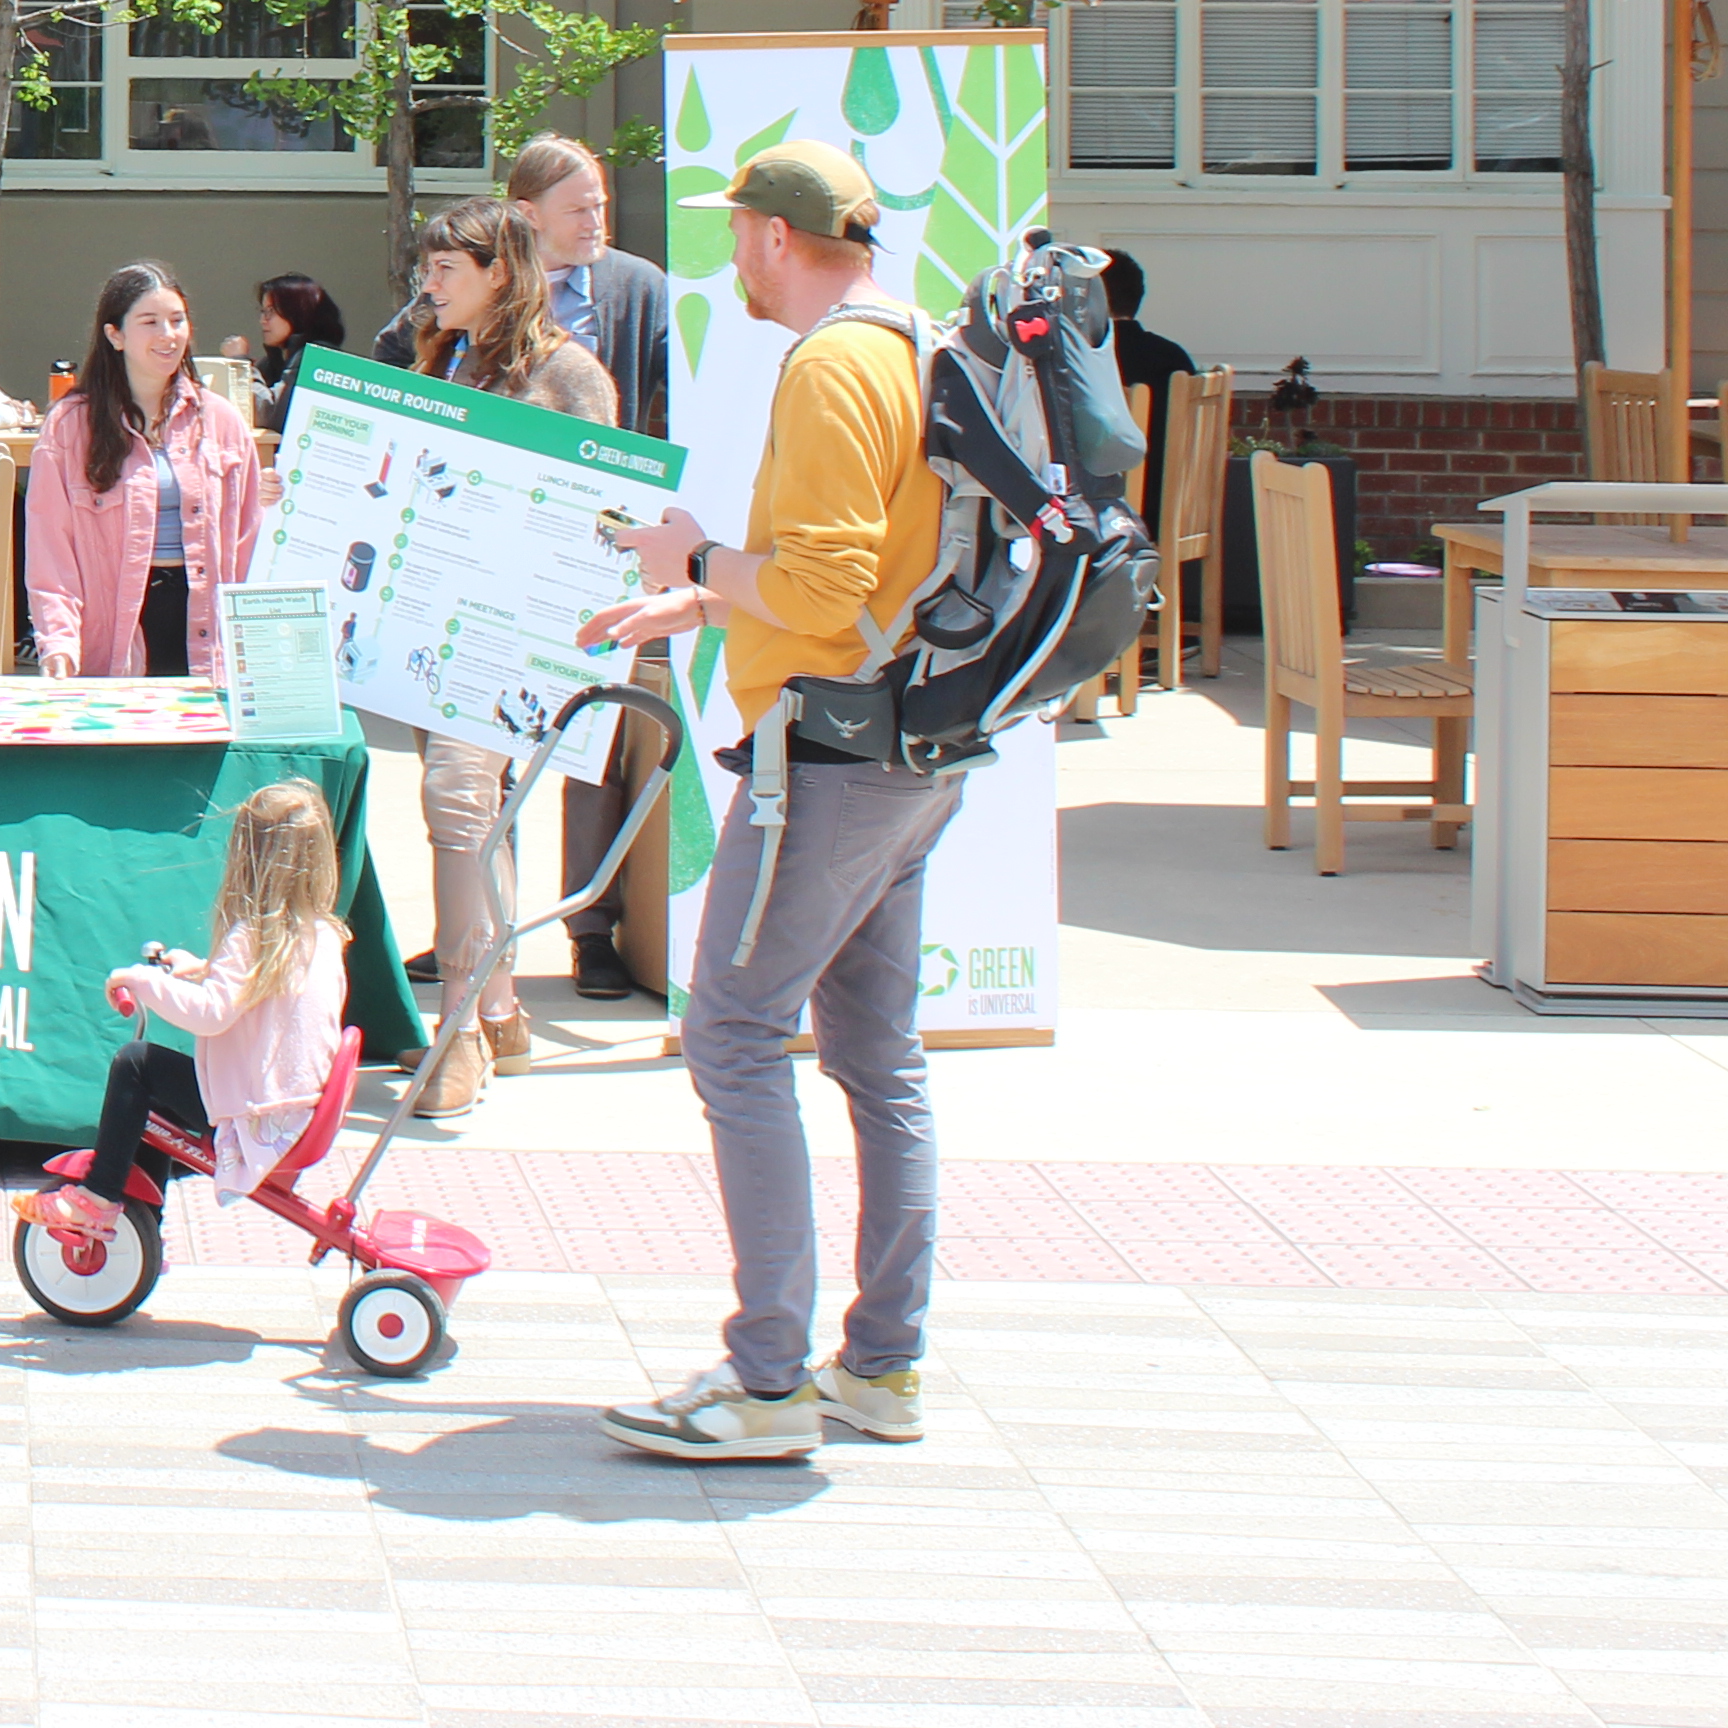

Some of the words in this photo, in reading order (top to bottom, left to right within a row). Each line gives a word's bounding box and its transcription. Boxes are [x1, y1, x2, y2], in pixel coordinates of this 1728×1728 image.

[313, 368, 361, 393] GREEN
[363, 381, 402, 404] YOUR
[402, 392, 469, 422] ROUTINE
[312, 419, 355, 438] MORNING
[314, 409, 344, 424] START
[344, 418, 370, 432] YOUR
[536, 472, 570, 489] LUNCH
[570, 482, 604, 498] BREAK
[242, 597, 261, 605] Earth
[285, 595, 307, 603] Watch
[456, 596, 468, 607] IN
[468, 598, 516, 621] MEETINGS
[530, 656, 552, 671] END
[553, 663, 579, 679] YOUR
[580, 672, 602, 684] DAY
[968, 946, 1035, 990] GREEN
[968, 994, 979, 1016] is
[980, 993, 1037, 1015] UNIVERSAL
